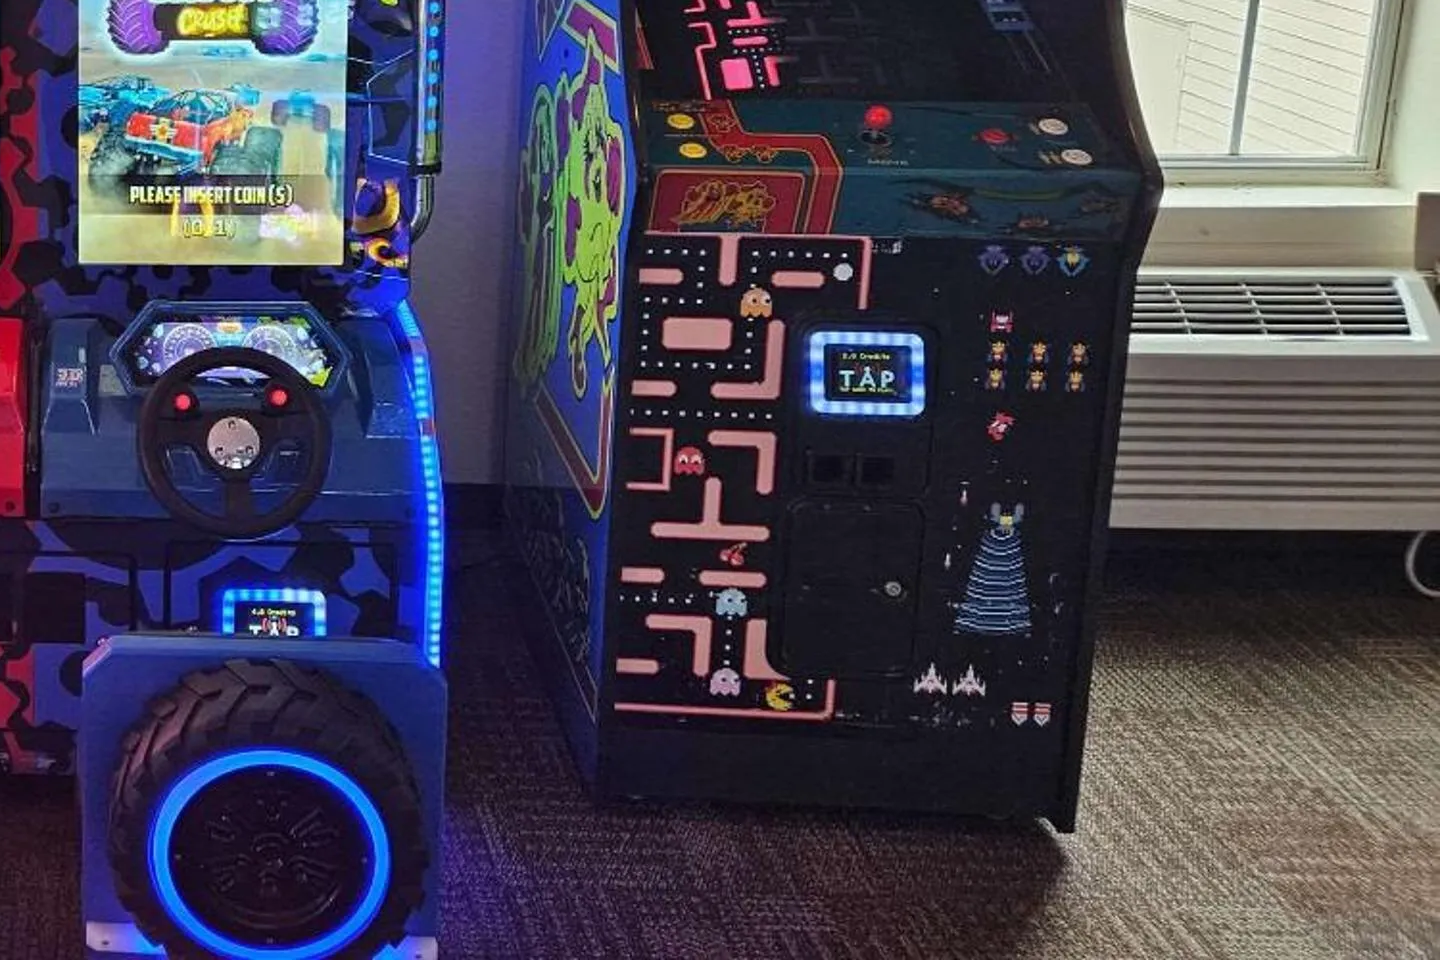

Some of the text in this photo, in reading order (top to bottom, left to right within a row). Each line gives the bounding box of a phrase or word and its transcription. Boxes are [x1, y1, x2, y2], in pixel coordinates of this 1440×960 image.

[177, 3, 249, 37] CRUSH
[130, 185, 182, 205] PLEASE
[184, 185, 232, 205] INSERT
[839, 367, 896, 389] TAP
